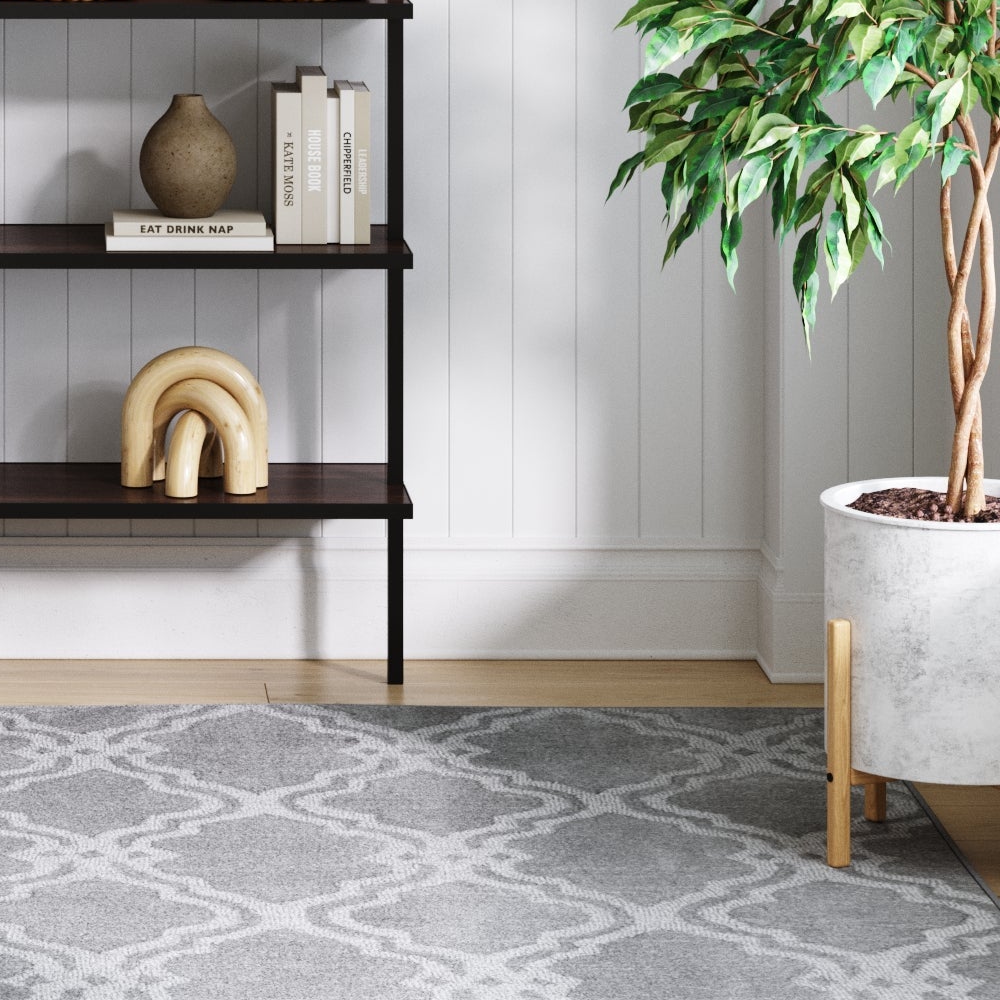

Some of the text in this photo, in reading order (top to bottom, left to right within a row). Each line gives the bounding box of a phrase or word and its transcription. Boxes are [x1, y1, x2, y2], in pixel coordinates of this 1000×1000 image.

[283, 141, 294, 207] KATE MOSS
[307, 129, 322, 192] HOUSE BOOK
[343, 131, 352, 195] CHIPPERFIELD
[358, 148, 368, 195] LEADERSHIP
[140, 225, 234, 233] EAT DRINK NAP
